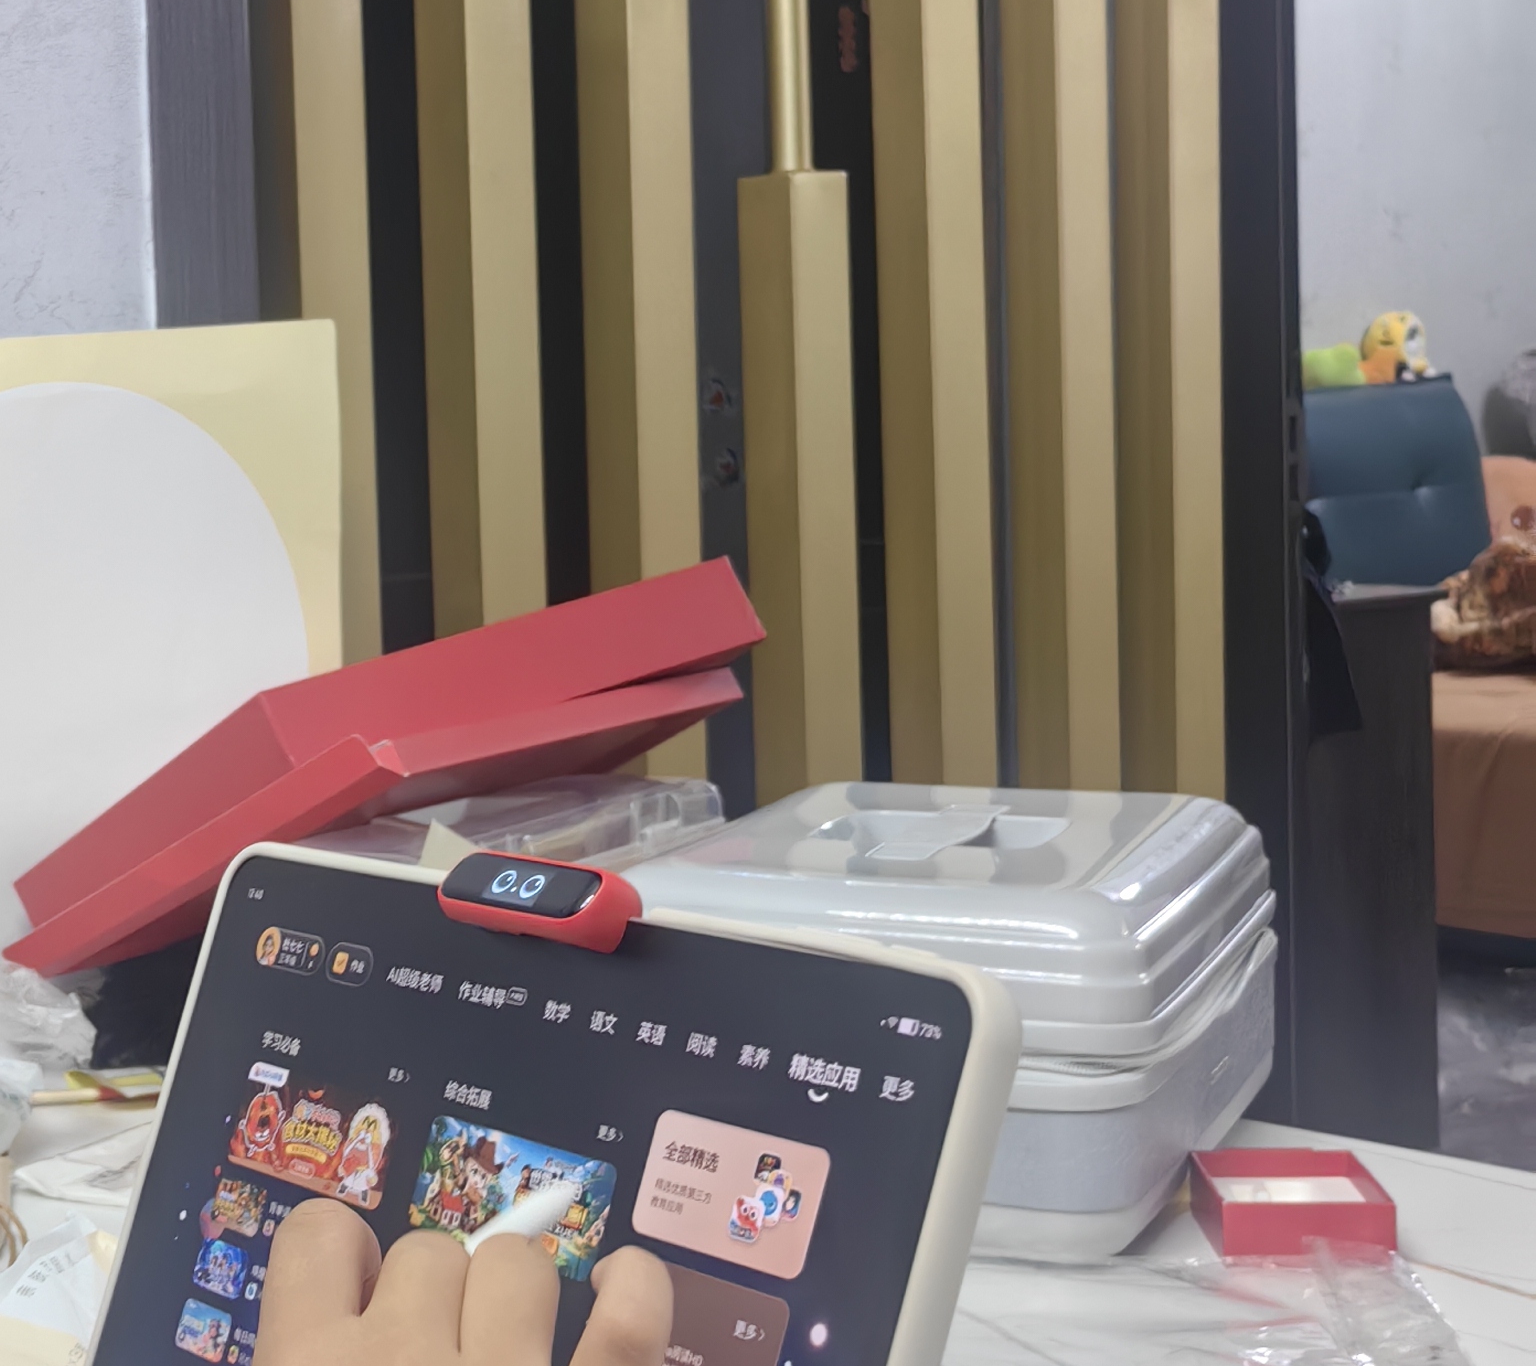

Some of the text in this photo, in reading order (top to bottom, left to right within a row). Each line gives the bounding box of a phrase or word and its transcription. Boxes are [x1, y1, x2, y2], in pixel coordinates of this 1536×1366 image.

[386, 966, 444, 994] AI超级老师
[457, 981, 508, 1009] 作业辅导
[542, 999, 571, 1023] 数学
[589, 1010, 618, 1035] 语文
[261, 1030, 301, 1057] 学习必备
[635, 1021, 668, 1047] 英语
[685, 1032, 718, 1059] 阅读
[737, 1043, 771, 1070] 素养
[788, 1053, 861, 1093] 精选应用
[443, 1080, 492, 1110] 综合拓展
[879, 1074, 915, 1102] 更多
[662, 1141, 720, 1173] 全部精选
